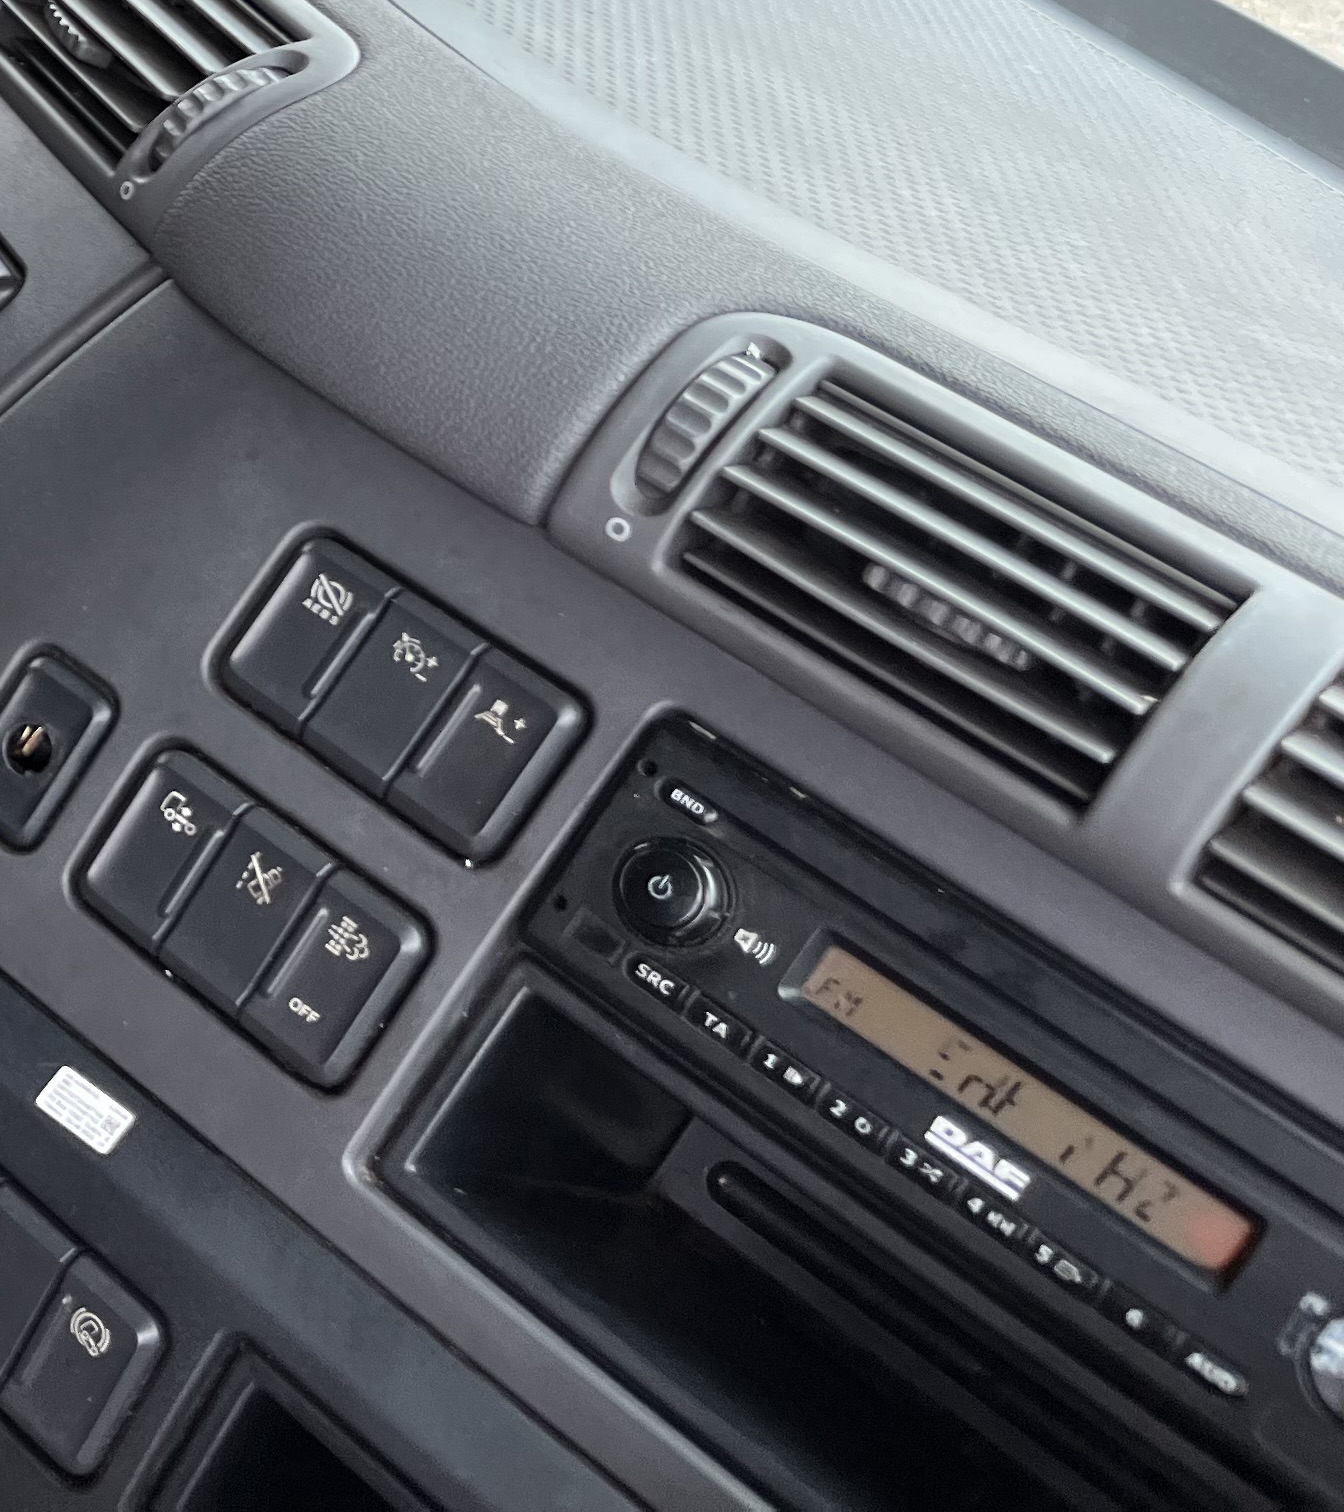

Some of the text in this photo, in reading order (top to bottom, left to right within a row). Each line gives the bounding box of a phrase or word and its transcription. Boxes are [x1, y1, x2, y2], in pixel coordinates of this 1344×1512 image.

[670, 788, 705, 815] BND
[635, 962, 675, 996] SRC
[288, 997, 321, 1023] OFF
[703, 1011, 729, 1039] TA
[829, 1099, 848, 1119] 2
[926, 1114, 1032, 1194] DAF
